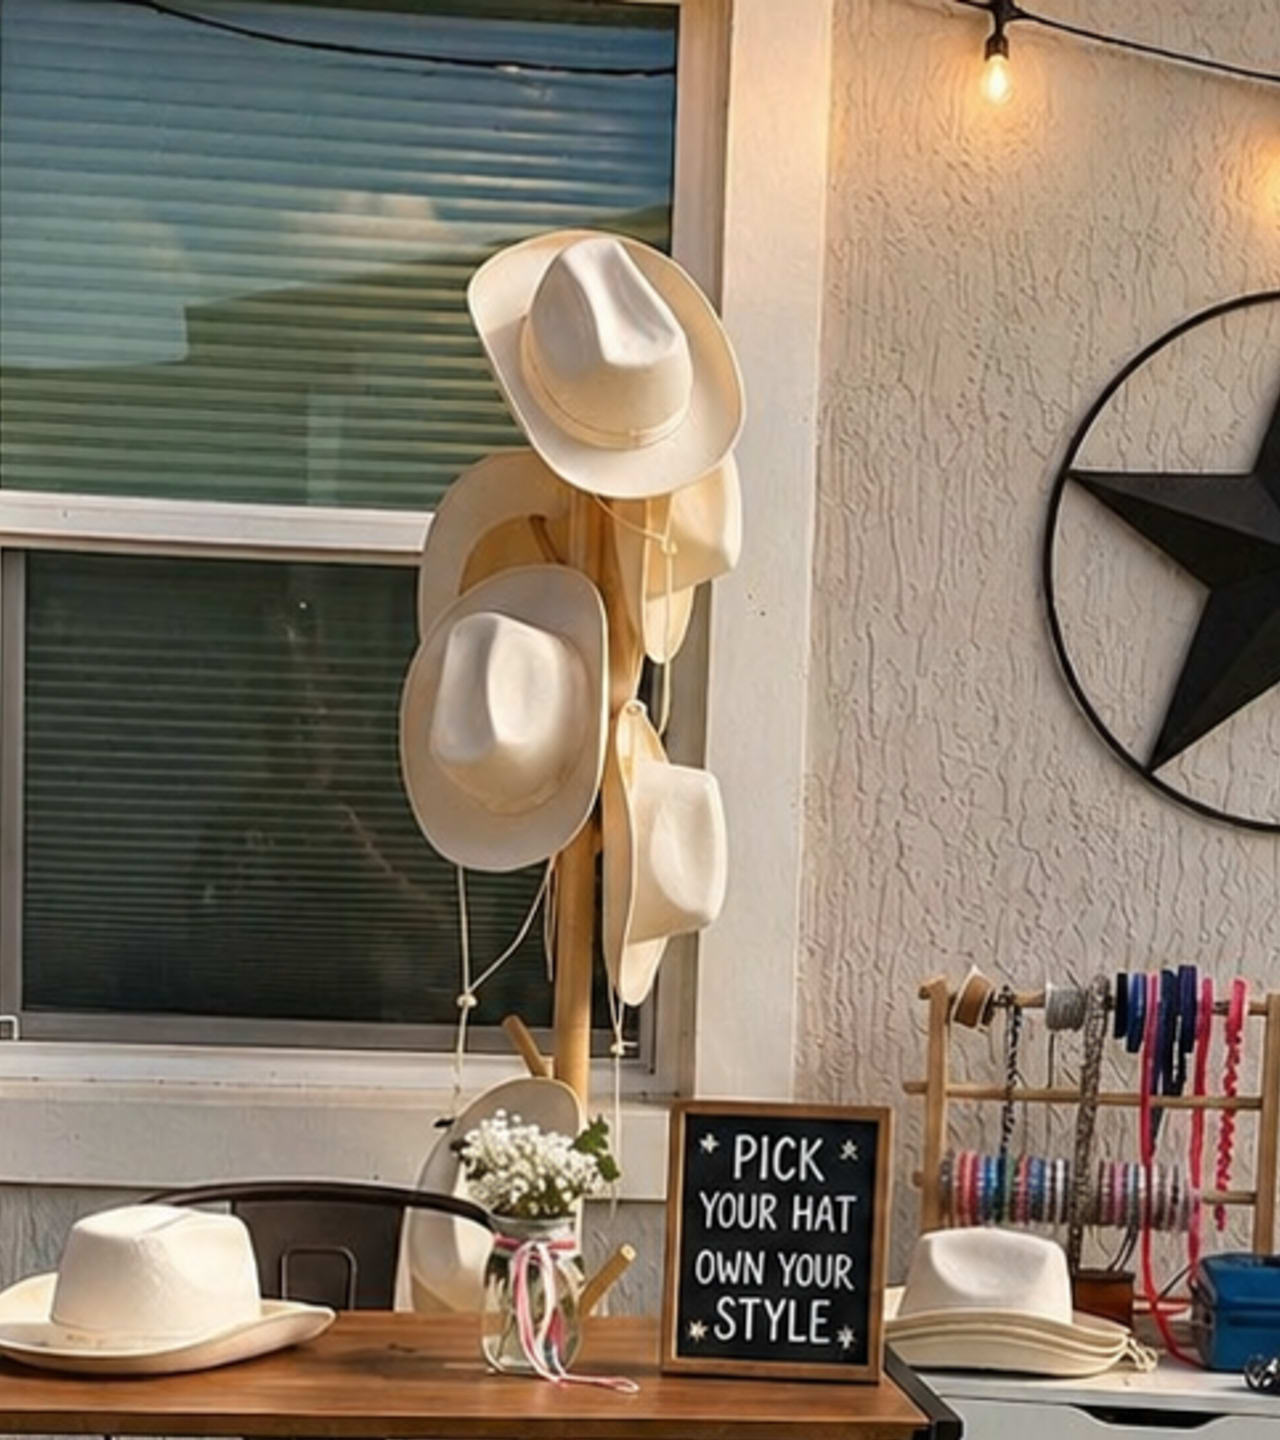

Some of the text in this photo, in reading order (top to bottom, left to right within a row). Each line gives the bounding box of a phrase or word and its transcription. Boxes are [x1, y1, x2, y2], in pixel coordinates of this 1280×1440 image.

[733, 1133, 825, 1182] PICK
[699, 1191, 857, 1233] YOUR HAT
[695, 1248, 855, 1291] OWN YOUR
[713, 1295, 832, 1345] STYLE
